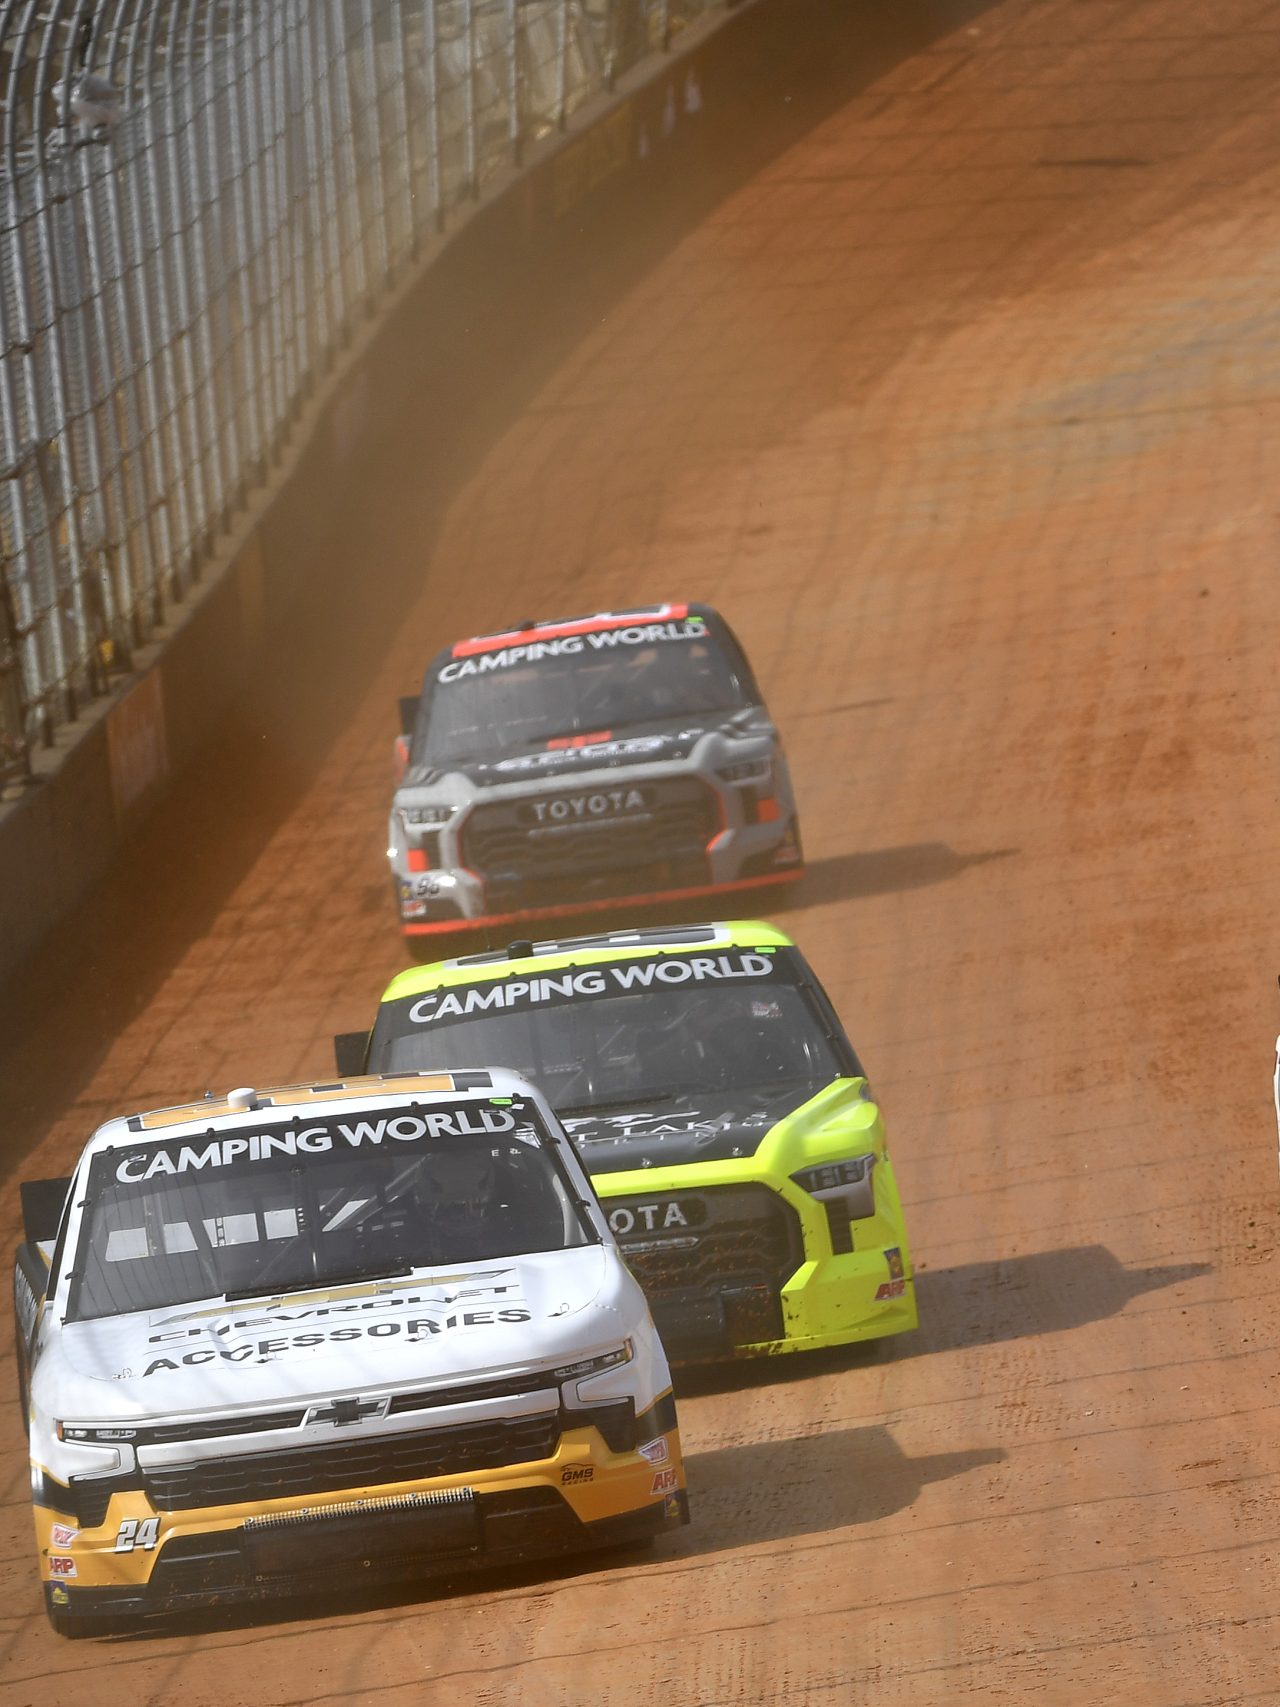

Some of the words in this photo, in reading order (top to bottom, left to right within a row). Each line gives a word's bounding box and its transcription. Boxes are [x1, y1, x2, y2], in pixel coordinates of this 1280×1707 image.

[438, 636, 583, 684] CAMPING
[586, 622, 706, 650] WORLD
[533, 790, 644, 822] TOYOTA
[408, 971, 606, 1024] CAMPING
[609, 955, 774, 989] WORLD
[115, 1126, 334, 1184] CAMPING
[336, 1109, 515, 1148] WORLD
[608, 1202, 688, 1235] OTA
[142, 1308, 532, 1378] ACCESSORIES
[561, 1468, 594, 1481] GMS
[115, 1517, 161, 1553] 24
